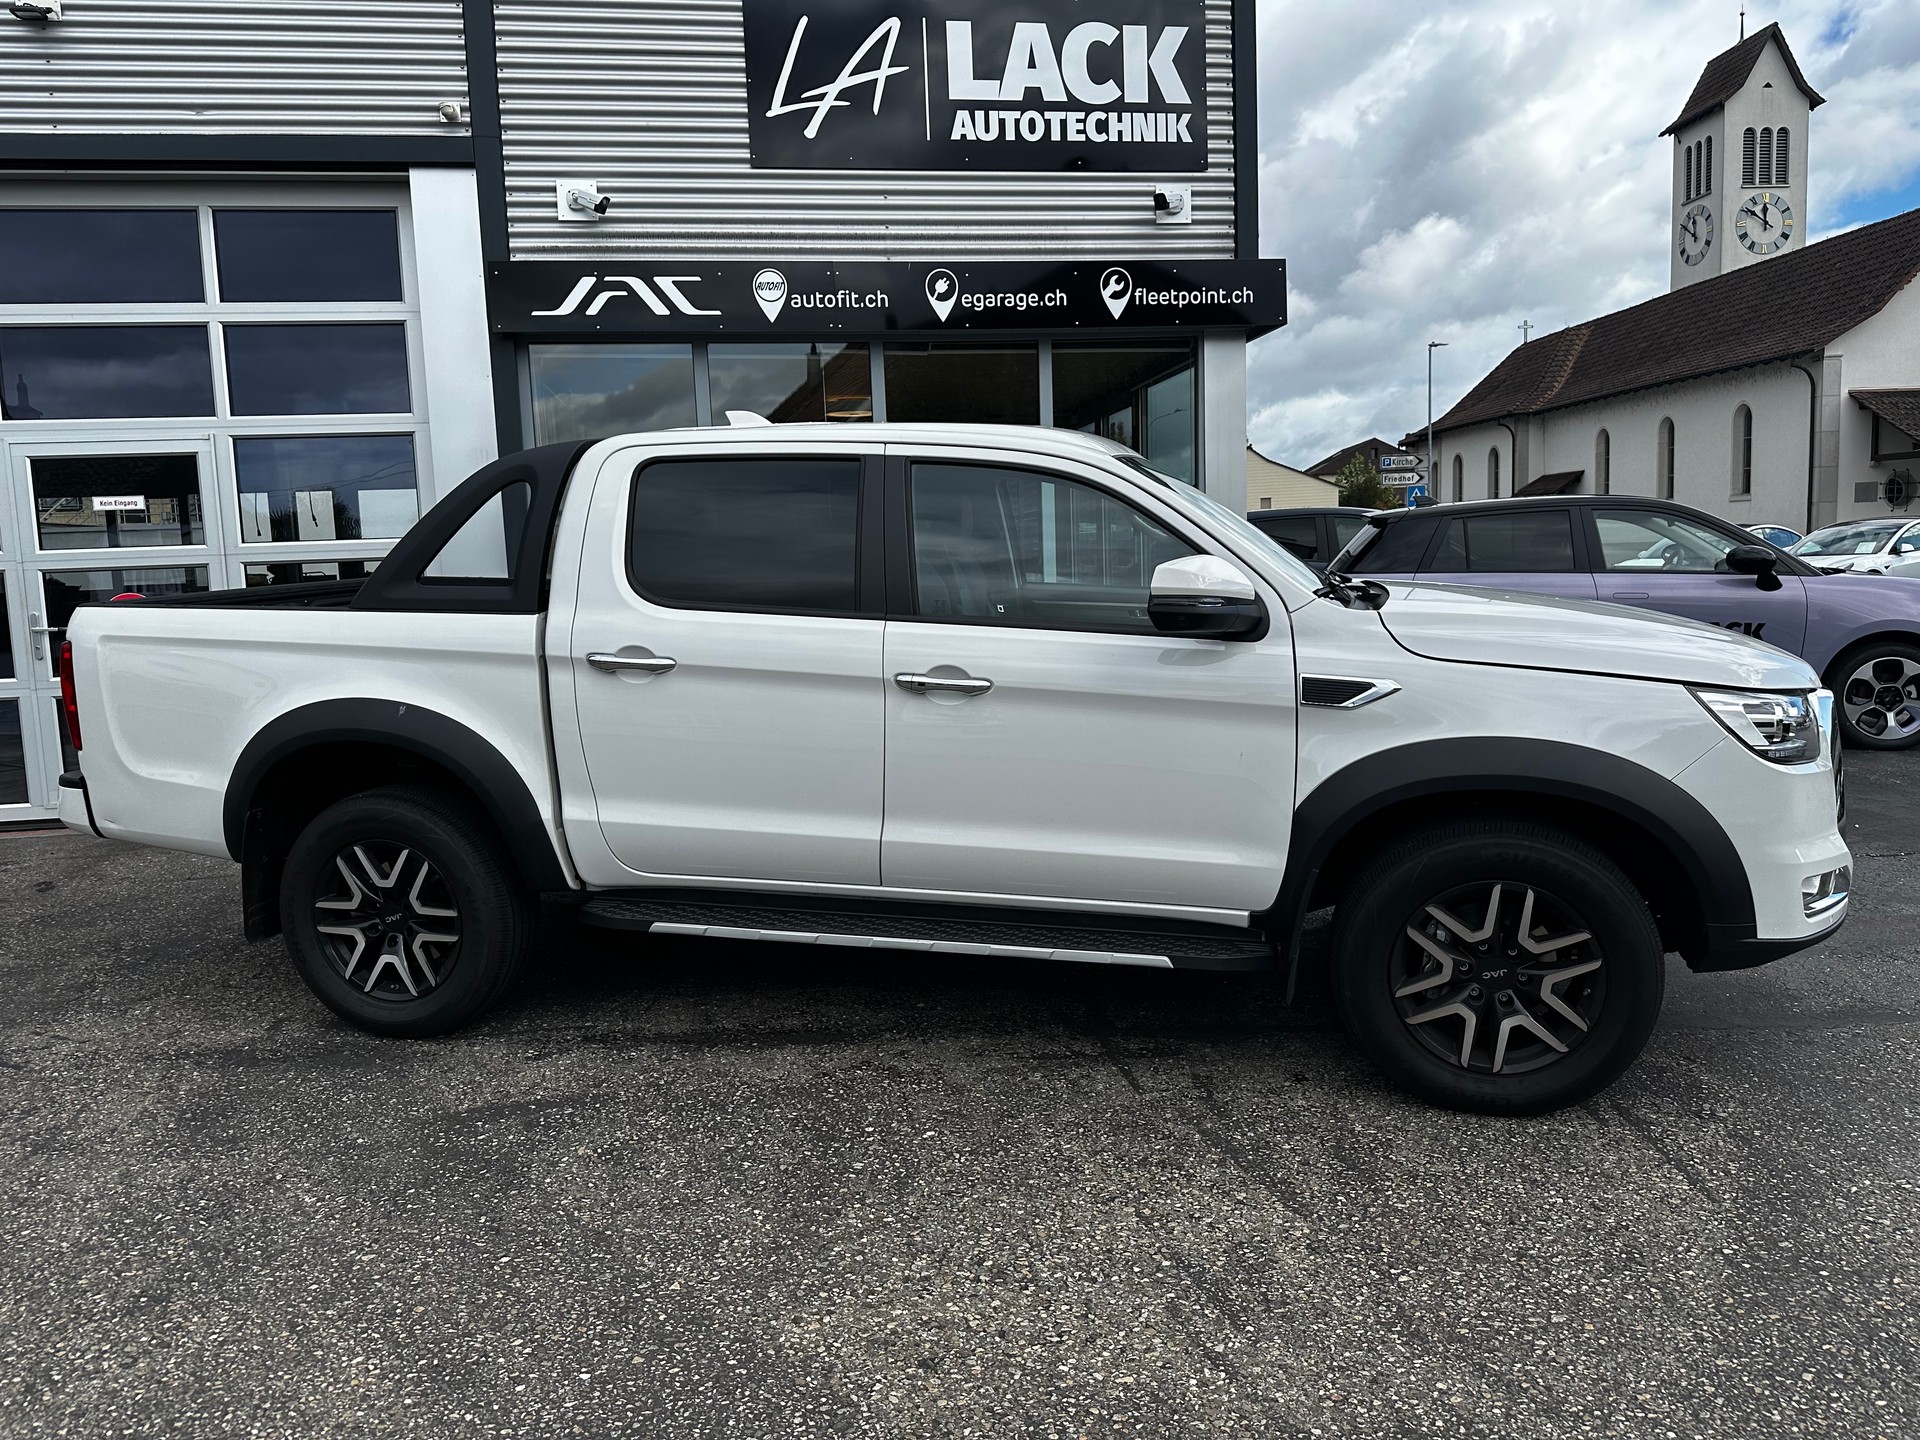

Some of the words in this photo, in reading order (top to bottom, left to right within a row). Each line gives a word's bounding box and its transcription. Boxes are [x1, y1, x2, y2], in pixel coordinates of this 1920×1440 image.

[945, 20, 1193, 105] LACK
[950, 109, 1194, 143] AUTOTECHNIK
[756, 281, 785, 292] AUTOFIT
[790, 289, 889, 308] autofit.ch
[961, 288, 1068, 311] egarage.ch
[1134, 286, 1254, 308] fleetpoint.ch
[1392, 457, 1414, 466] Kirche
[1383, 475, 1415, 483] Friedhof
[384, 912, 403, 923] JAC
[1481, 969, 1508, 979] JAC
